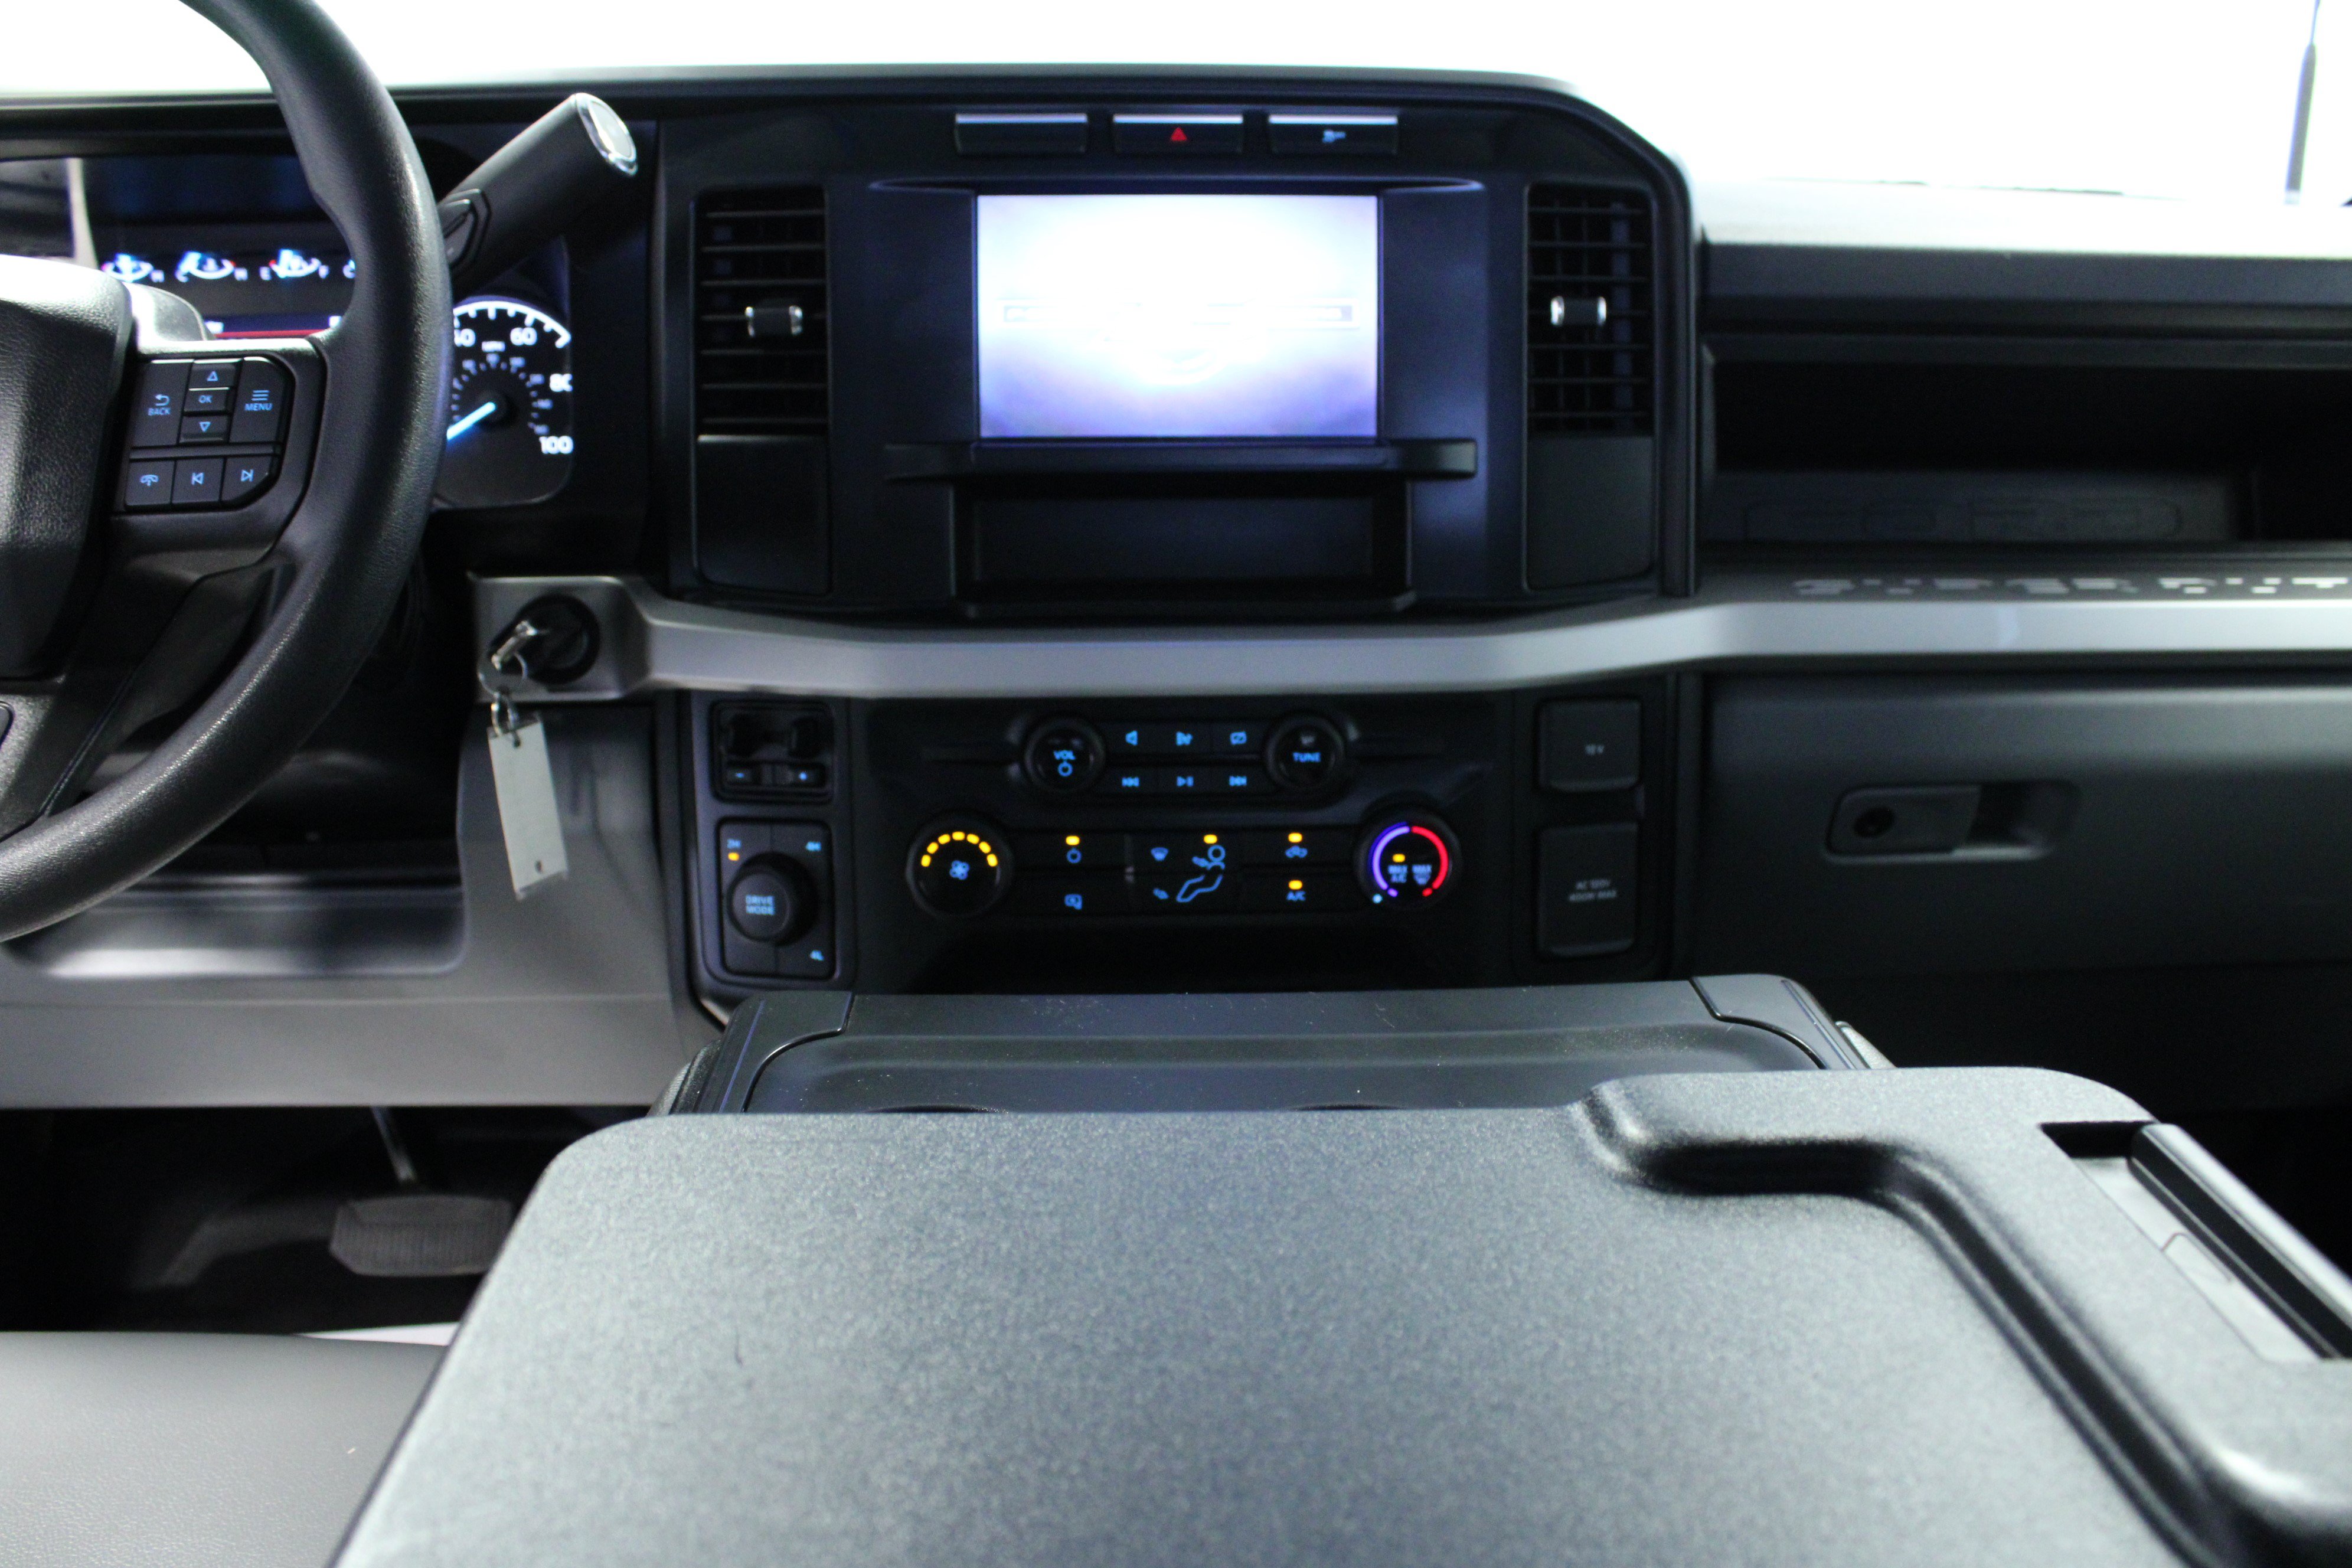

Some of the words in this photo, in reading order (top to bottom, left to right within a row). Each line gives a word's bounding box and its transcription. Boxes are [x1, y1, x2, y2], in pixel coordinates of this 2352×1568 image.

[510, 327, 537, 346] 60
[198, 395, 213, 403] OK
[148, 407, 171, 416] BACK
[244, 403, 273, 411] MENU
[539, 435, 574, 455] 100
[1054, 750, 1076, 760] VOL
[1293, 752, 1321, 762] TUNE
[746, 894, 775, 904] DRIVE
[1287, 891, 1306, 901] A/C
[746, 905, 775, 915] MODE
